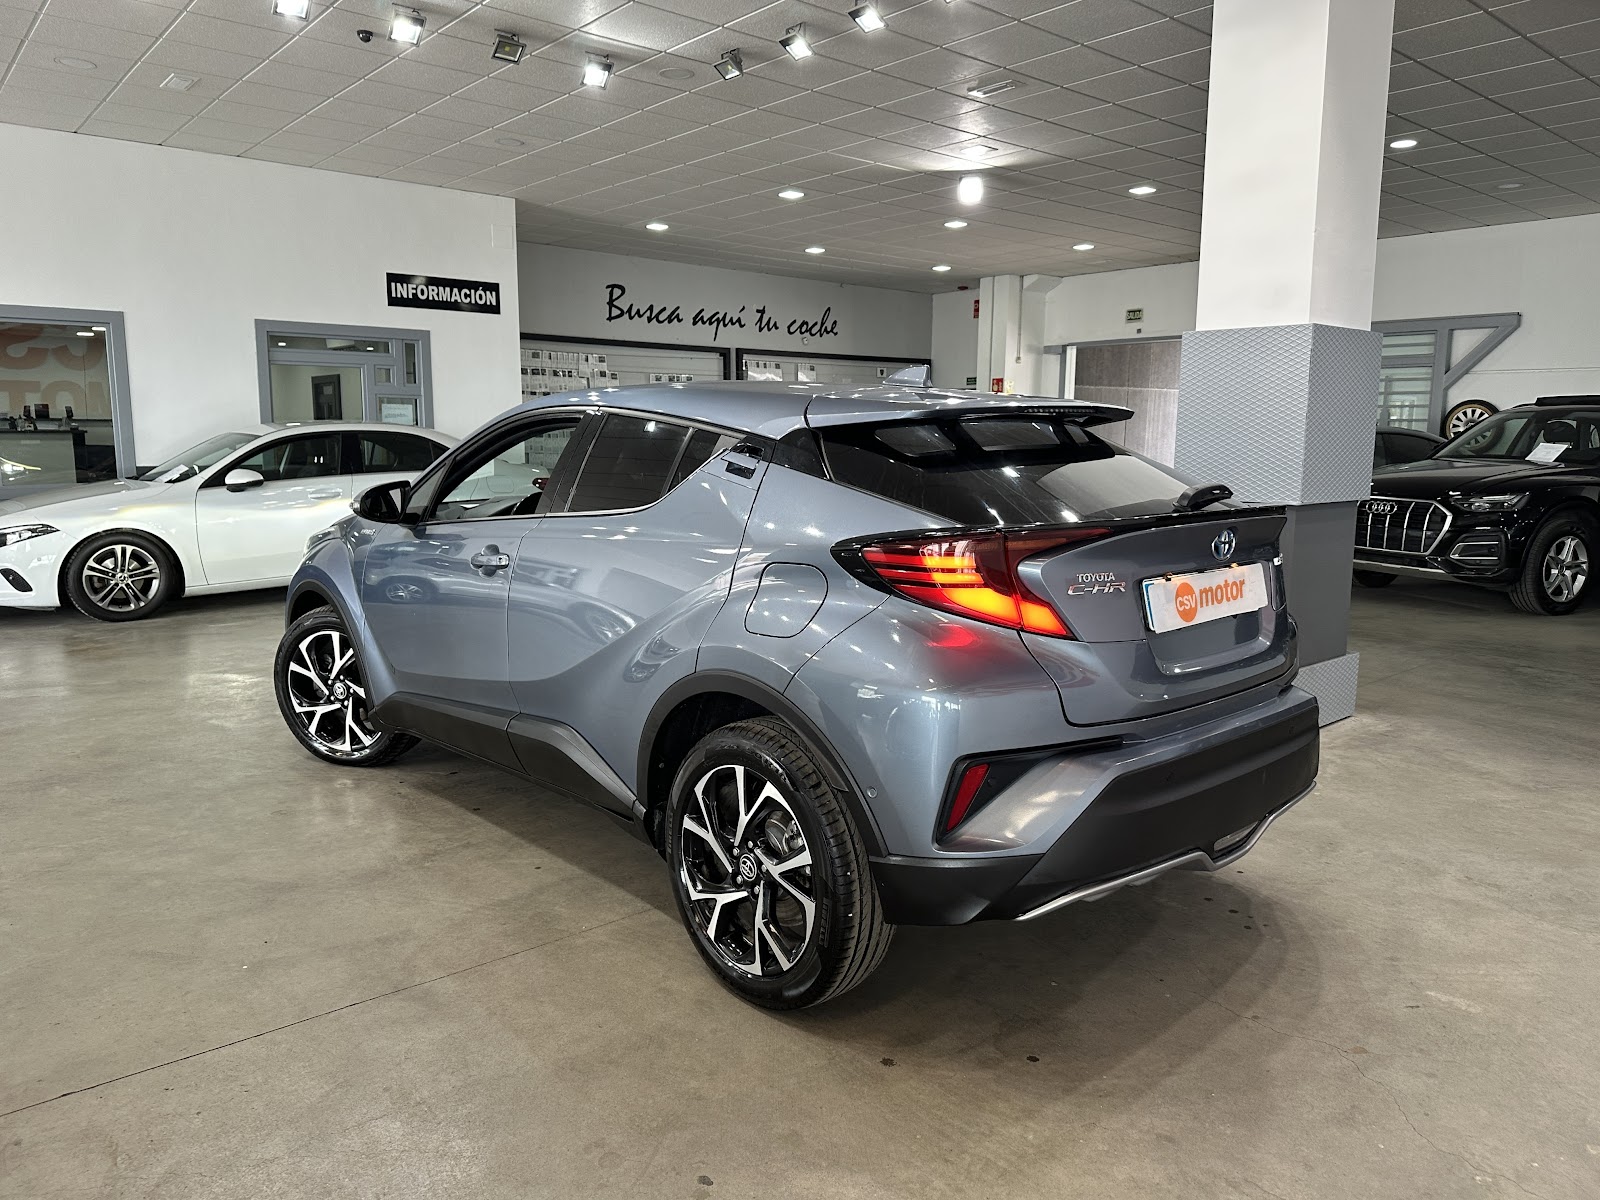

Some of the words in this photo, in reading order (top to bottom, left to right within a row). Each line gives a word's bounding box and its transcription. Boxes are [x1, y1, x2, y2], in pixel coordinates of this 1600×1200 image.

[391, 282, 496, 306] INFORMACIÓN
[605, 283, 683, 323] Busca
[692, 305, 746, 341] aquí
[755, 305, 779, 332] tu
[787, 306, 838, 337] coche
[1067, 581, 1126, 595] C-HR
[1076, 572, 1115, 583] TOYOTA
[1199, 579, 1245, 608] motor
